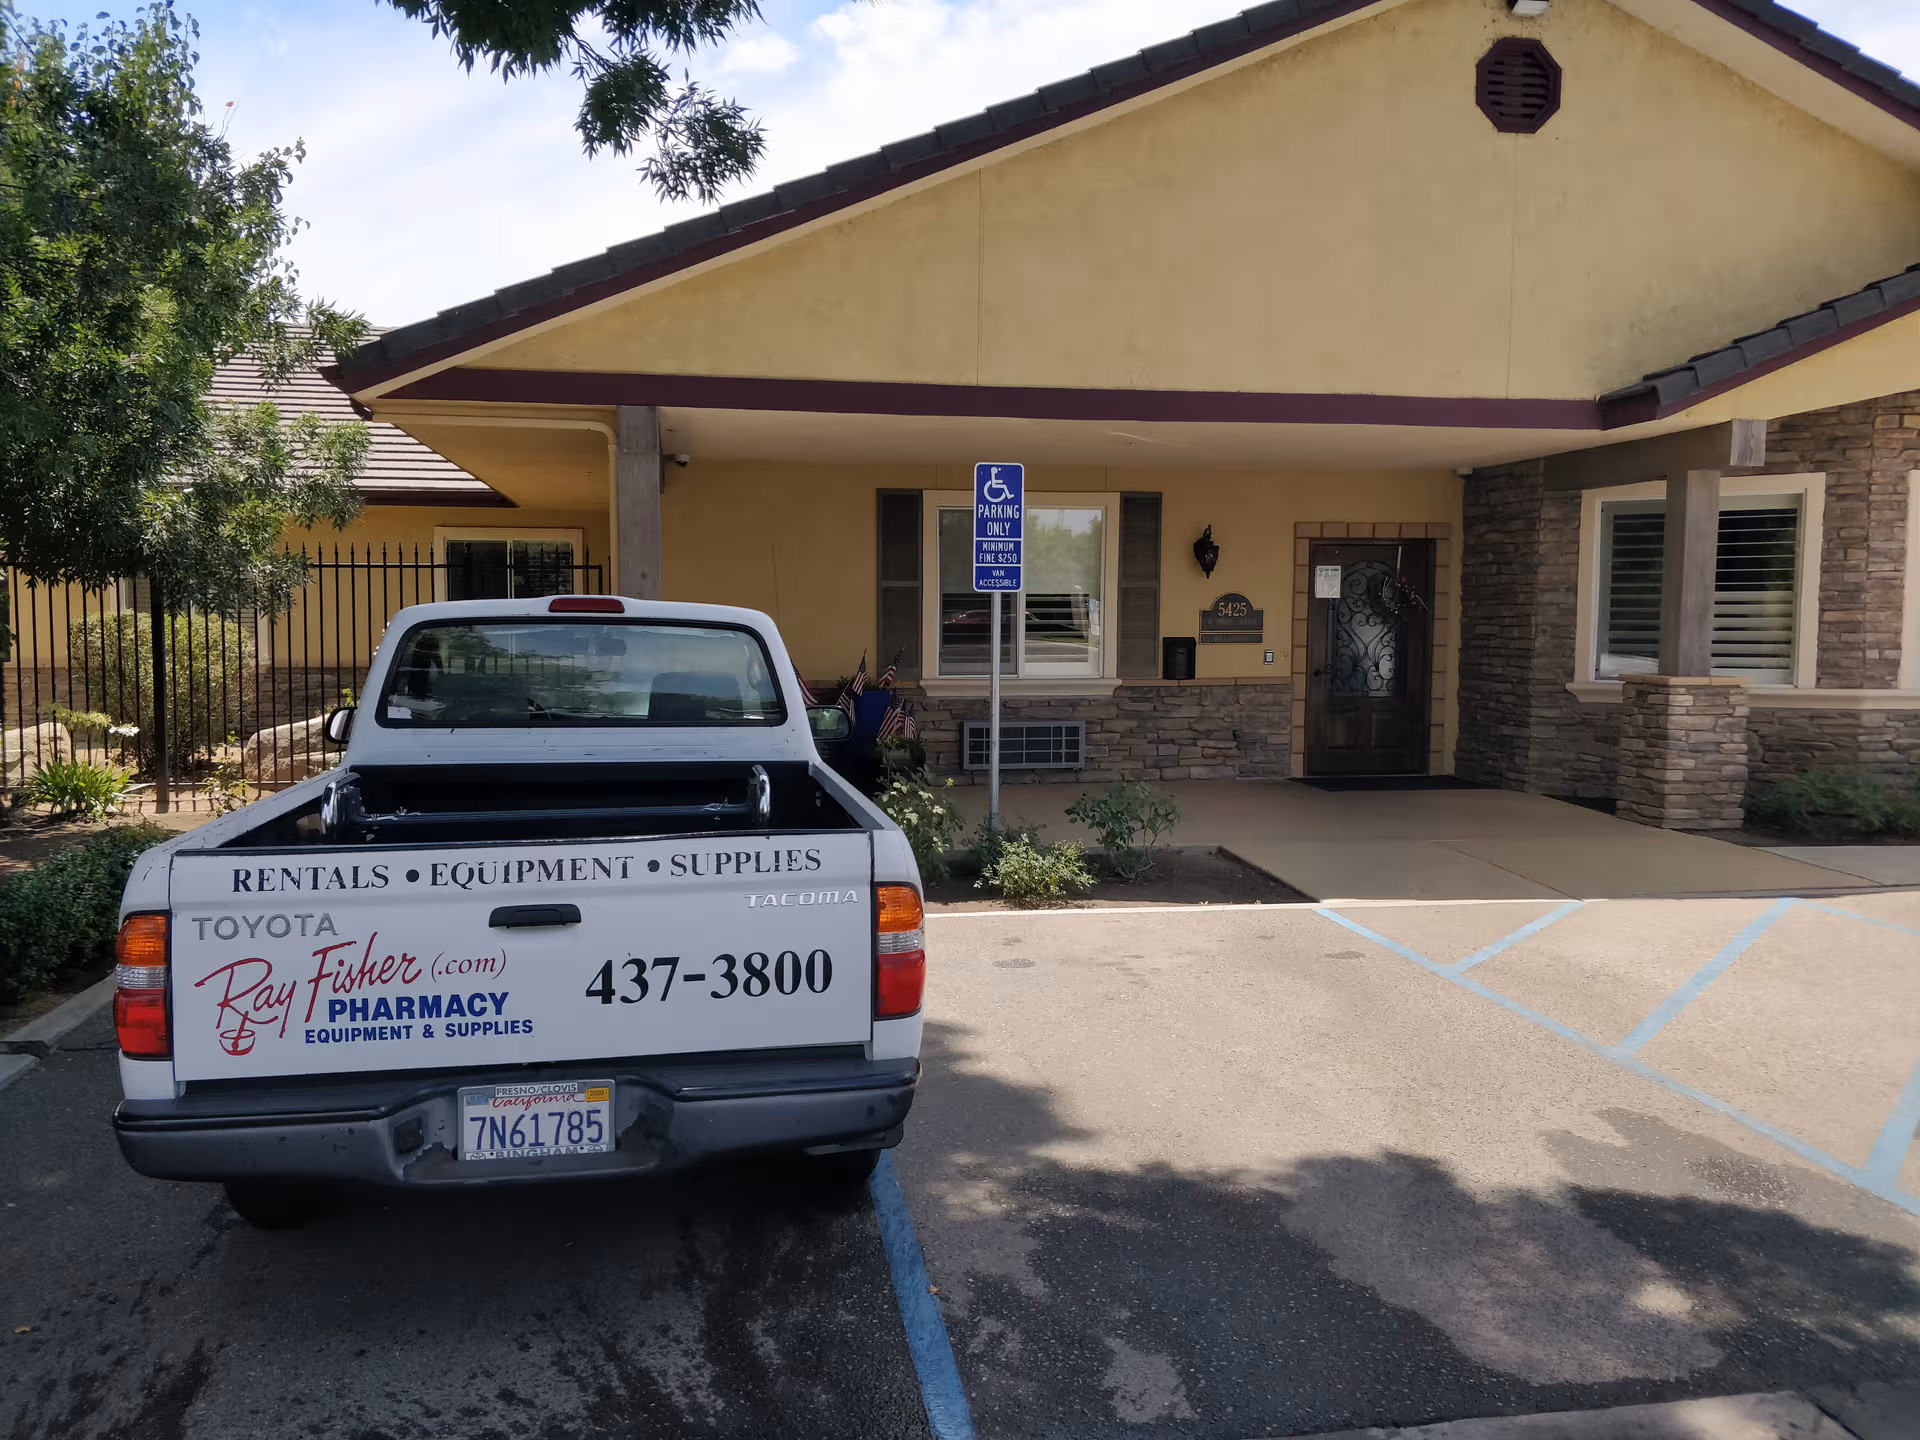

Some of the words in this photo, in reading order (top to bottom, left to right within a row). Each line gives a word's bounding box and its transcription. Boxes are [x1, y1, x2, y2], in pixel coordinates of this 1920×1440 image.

[978, 504, 1020, 519] PARKING
[987, 521, 1011, 536] ONLY
[982, 541, 1014, 552] MINIMUM
[979, 553, 995, 563] FINE
[998, 553, 1018, 563] $250
[992, 569, 1005, 577] VAN
[979, 579, 1017, 588] ACCESSIBLE
[1218, 602, 1247, 617] 5425
[232, 864, 390, 893] RENTALS
[430, 855, 634, 890] EQUIPMENT
[670, 849, 821, 877] SUPPLIES
[744, 890, 859, 909] TACOMA
[192, 913, 339, 941] TOYOTA
[194, 957, 298, 1039] Ray
[304, 932, 422, 1023] Fisher
[430, 948, 507, 983] (.com)
[585, 949, 833, 1005] 437-3800
[328, 992, 510, 1023] PHARMACY
[305, 1025, 413, 1044] EQUIPMENT
[422, 1024, 435, 1039] &
[445, 1020, 534, 1038] SUPPLIES
[496, 1084, 577, 1096] FRESNO/CLOVIS
[492, 1094, 577, 1111] California
[470, 1109, 603, 1151] 7N61785
